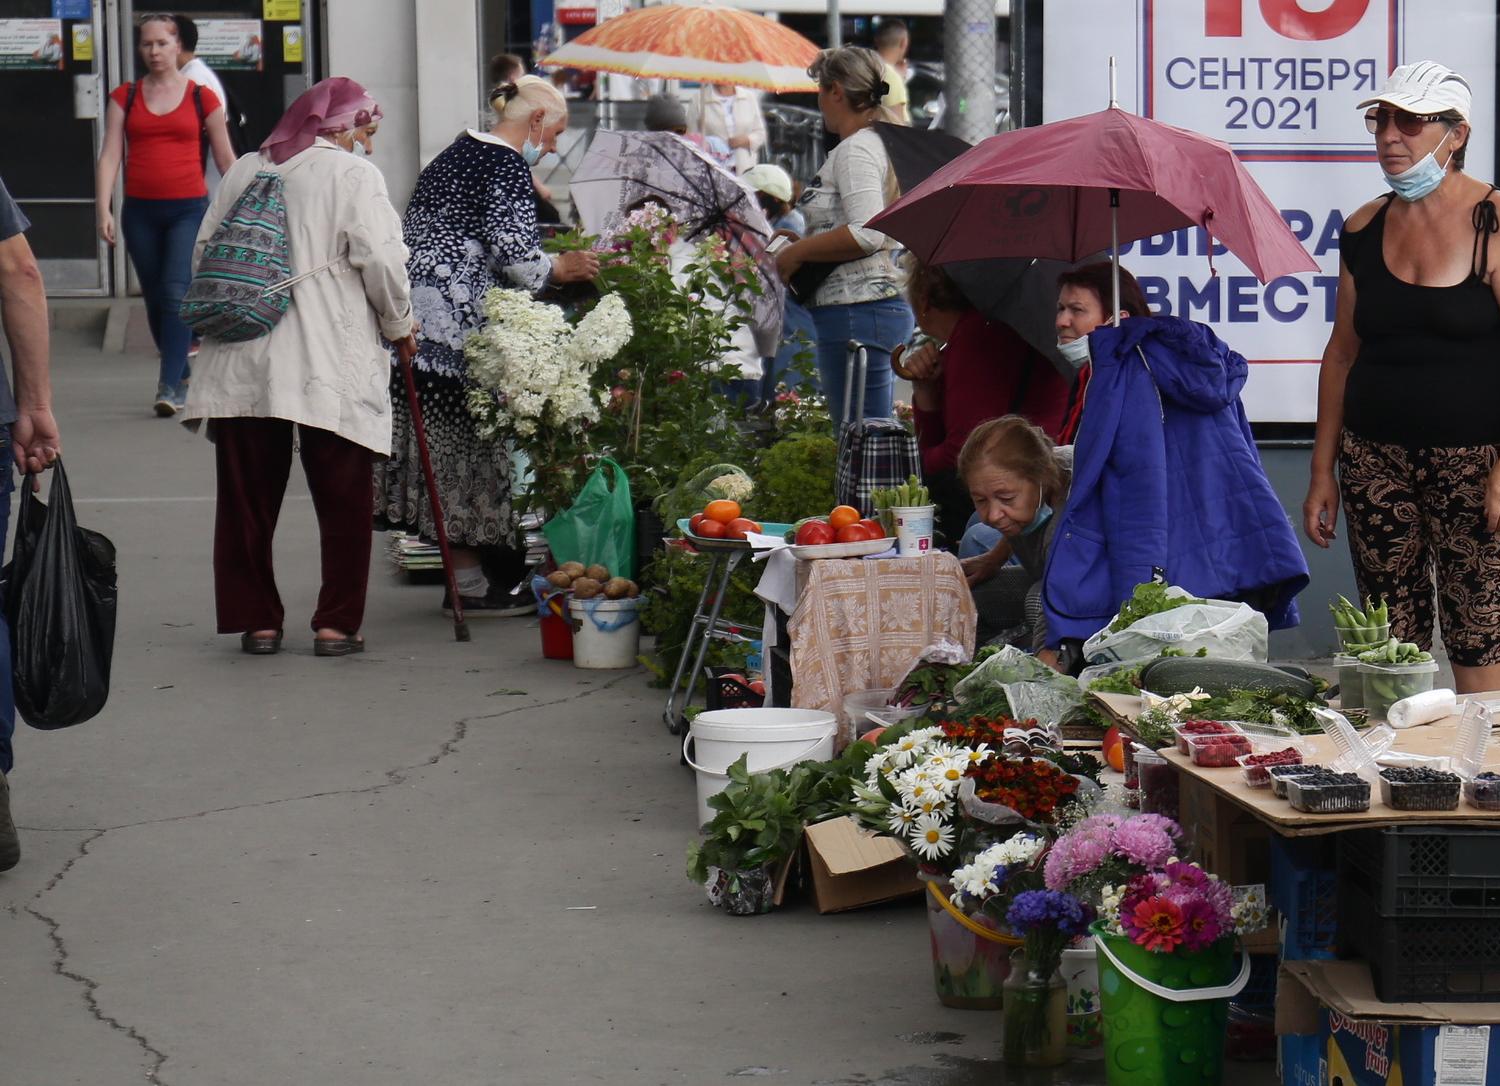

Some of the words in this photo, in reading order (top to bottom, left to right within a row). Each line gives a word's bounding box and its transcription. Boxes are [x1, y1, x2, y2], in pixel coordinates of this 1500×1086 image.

[1165, 57, 1377, 91] СЕНТЯБРЯ
[1224, 97, 1318, 130] 2021
[1136, 275, 1340, 323] ВМЕСТ
[1364, 1040, 1389, 1080] fruit
